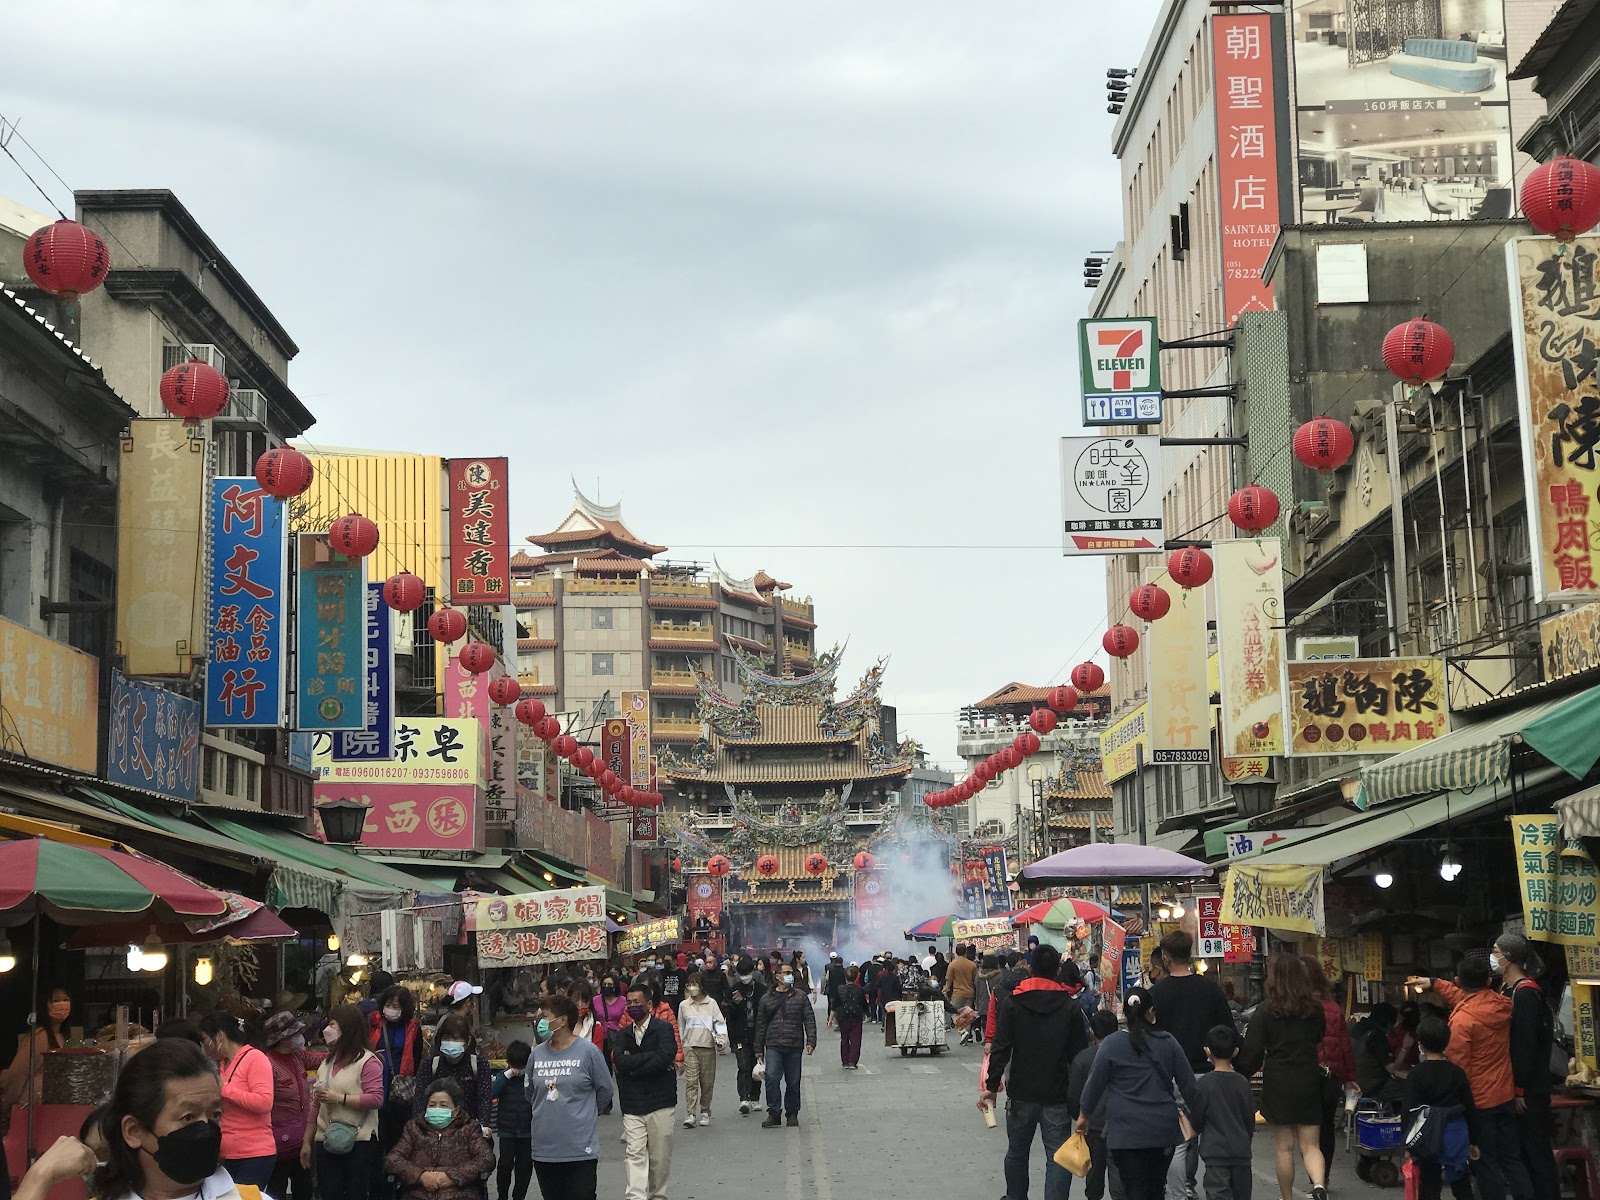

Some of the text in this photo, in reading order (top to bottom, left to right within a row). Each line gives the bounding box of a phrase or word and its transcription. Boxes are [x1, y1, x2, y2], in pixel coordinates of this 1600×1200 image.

[1225, 25, 1267, 210] 朝聖酒店
[1364, 100, 1447, 111] 160坪飯店大廳
[1556, 161, 1574, 211] 風調雨順
[1224, 223, 1278, 235] SAINT ART
[1233, 238, 1273, 248] HOTEL
[1226, 260, 1241, 268] (05)
[1410, 322, 1427, 364] 風調雨順
[1139, 403, 1158, 411] Wi-Fi
[469, 465, 487, 485] 陳
[1084, 470, 1108, 479] 咖啡
[220, 485, 274, 600] 阿文
[462, 490, 496, 577] 美達香
[1550, 476, 1598, 590] 鴨肉飯
[246, 604, 275, 664] 食品
[218, 668, 266, 720] 行
[109, 685, 154, 782] 阿文
[1369, 720, 1436, 742] 鴨肉飯
[176, 709, 197, 792] 行
[1155, 751, 1209, 762] 05-7833029
[335, 767, 351, 776] 電話
[1229, 761, 1263, 777] 彩券
[432, 801, 461, 832] 張
[712, 857, 871, 873] 上 聖 母 千
[1519, 823, 1550, 932] 冷氣開放
[482, 927, 602, 960] 透抽碳烤
[537, 1067, 572, 1077] CASUAL
